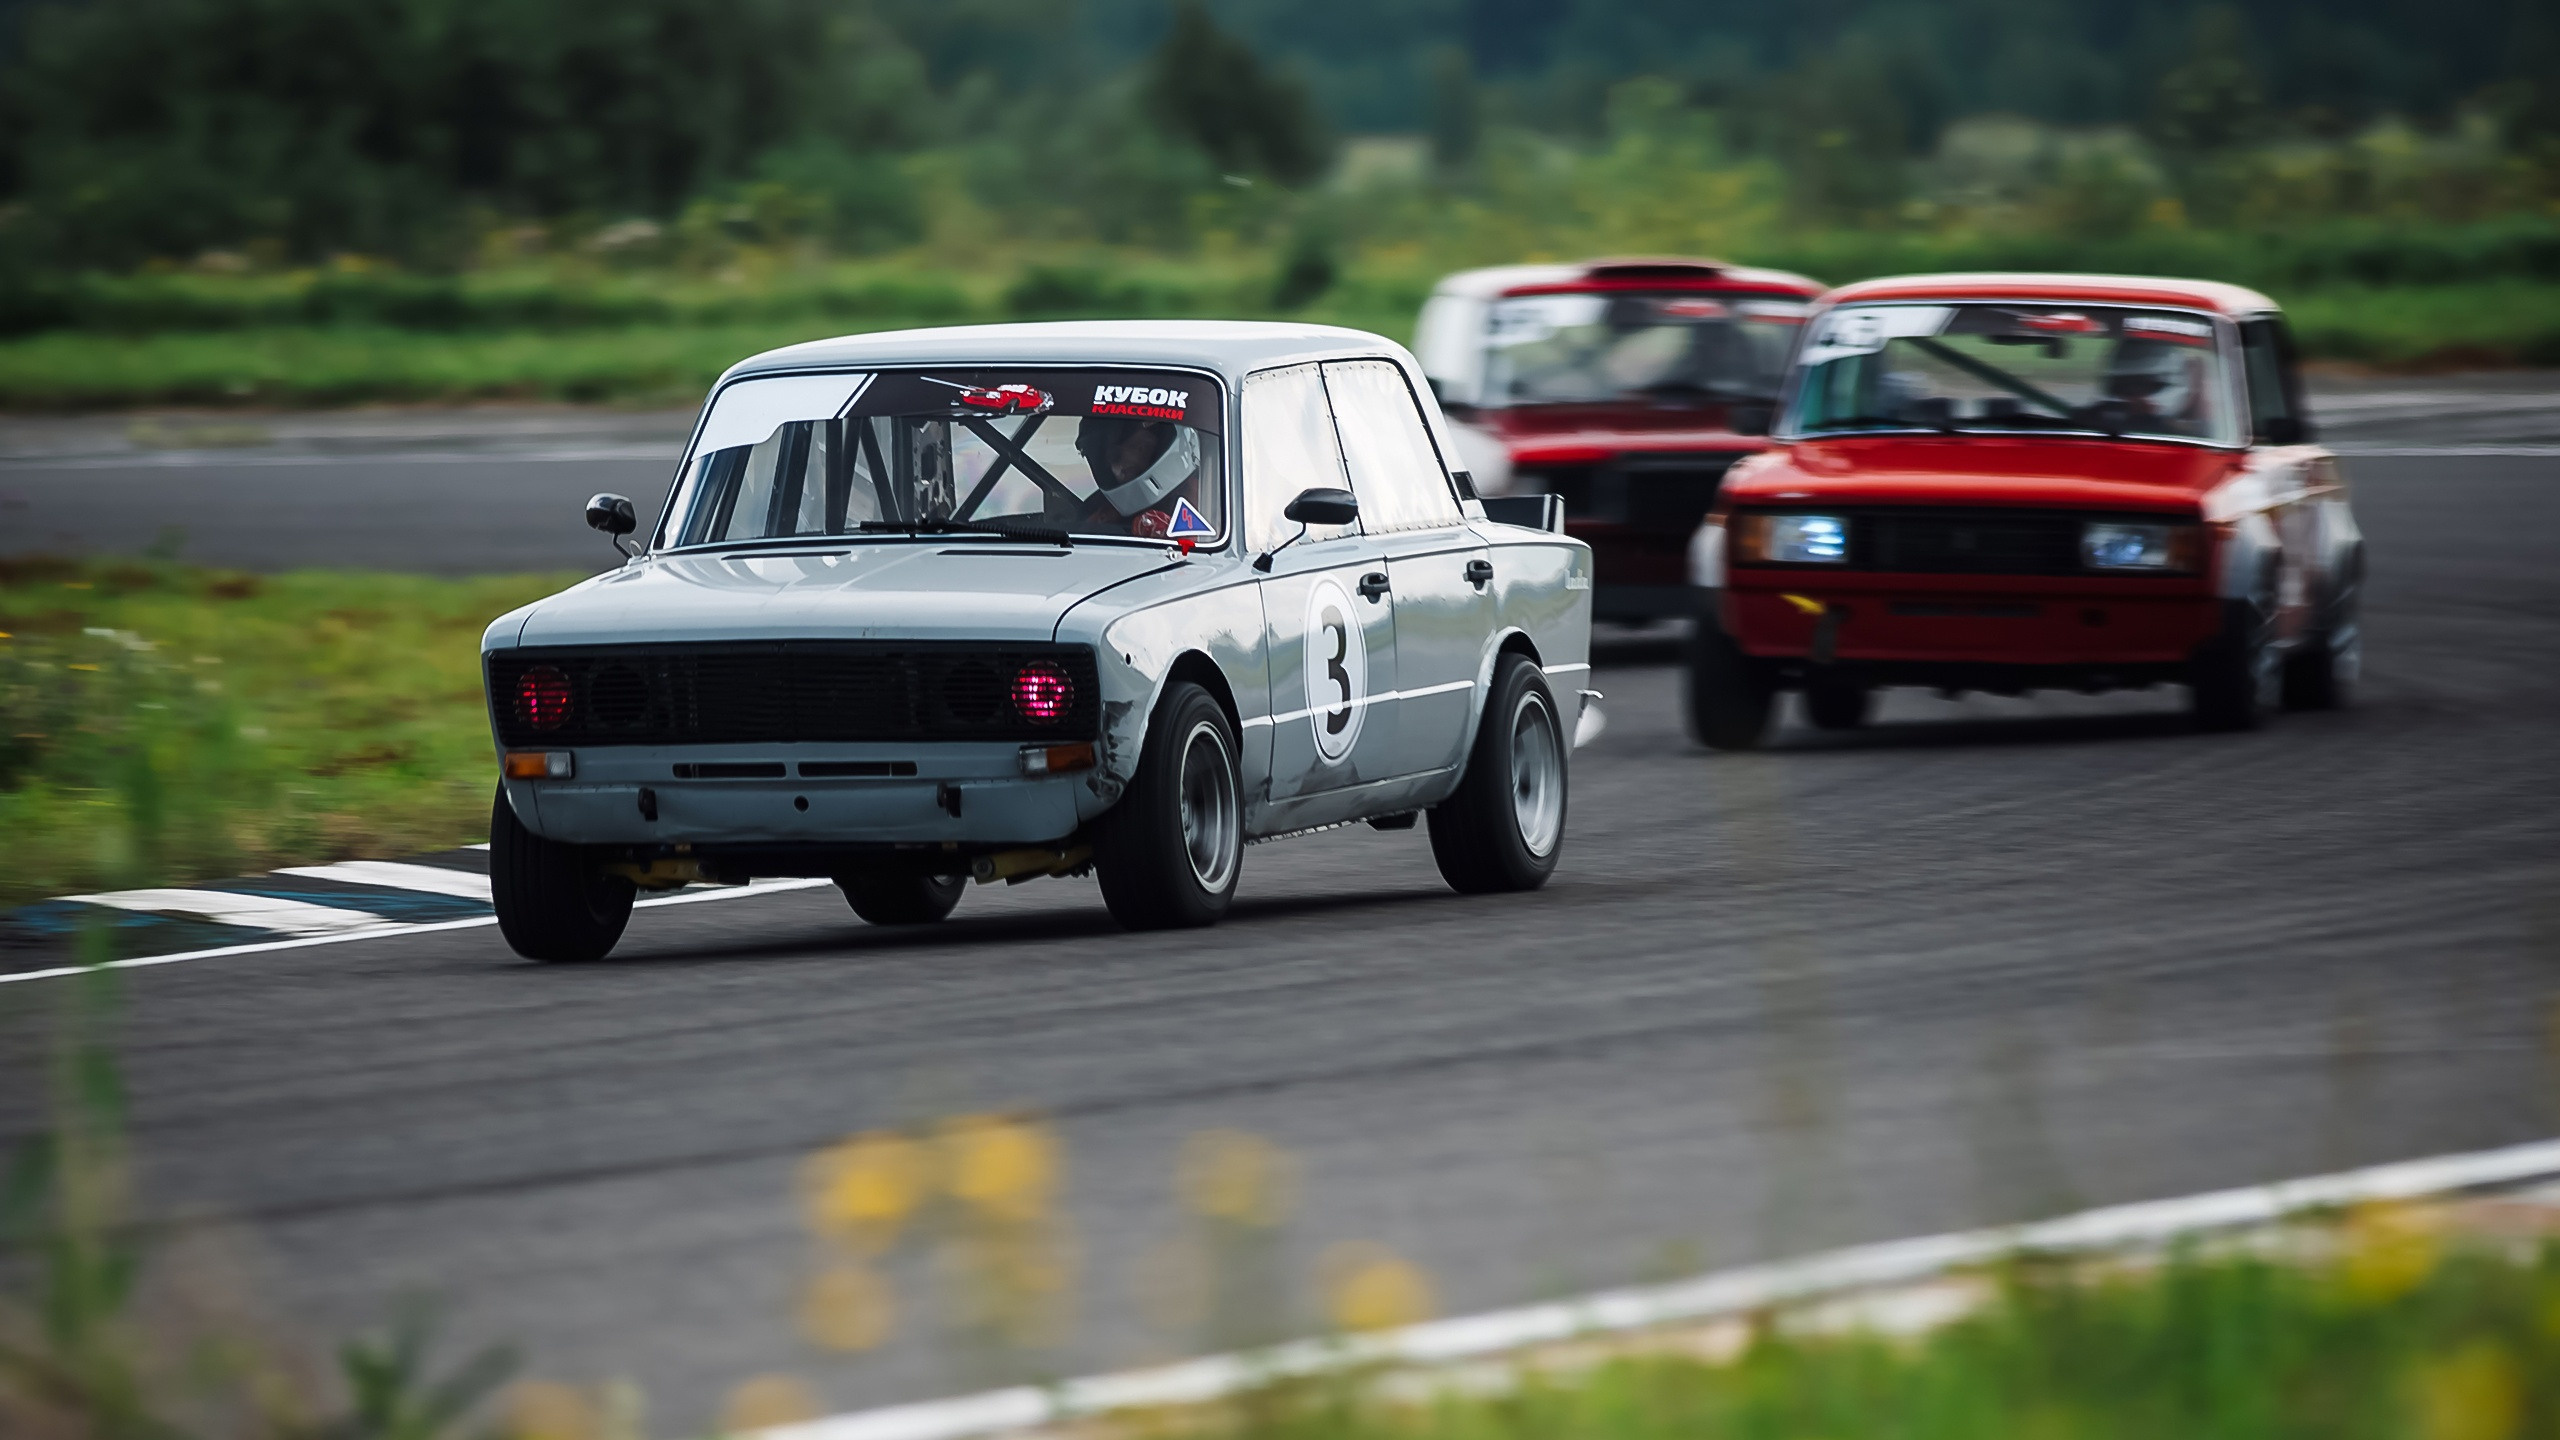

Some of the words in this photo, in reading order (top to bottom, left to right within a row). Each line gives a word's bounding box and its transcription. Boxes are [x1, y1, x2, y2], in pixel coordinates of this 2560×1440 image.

[1094, 385, 1189, 408] КУБОК
[1092, 404, 1185, 420] КЛАССИКИ
[1320, 604, 1352, 735] 3
